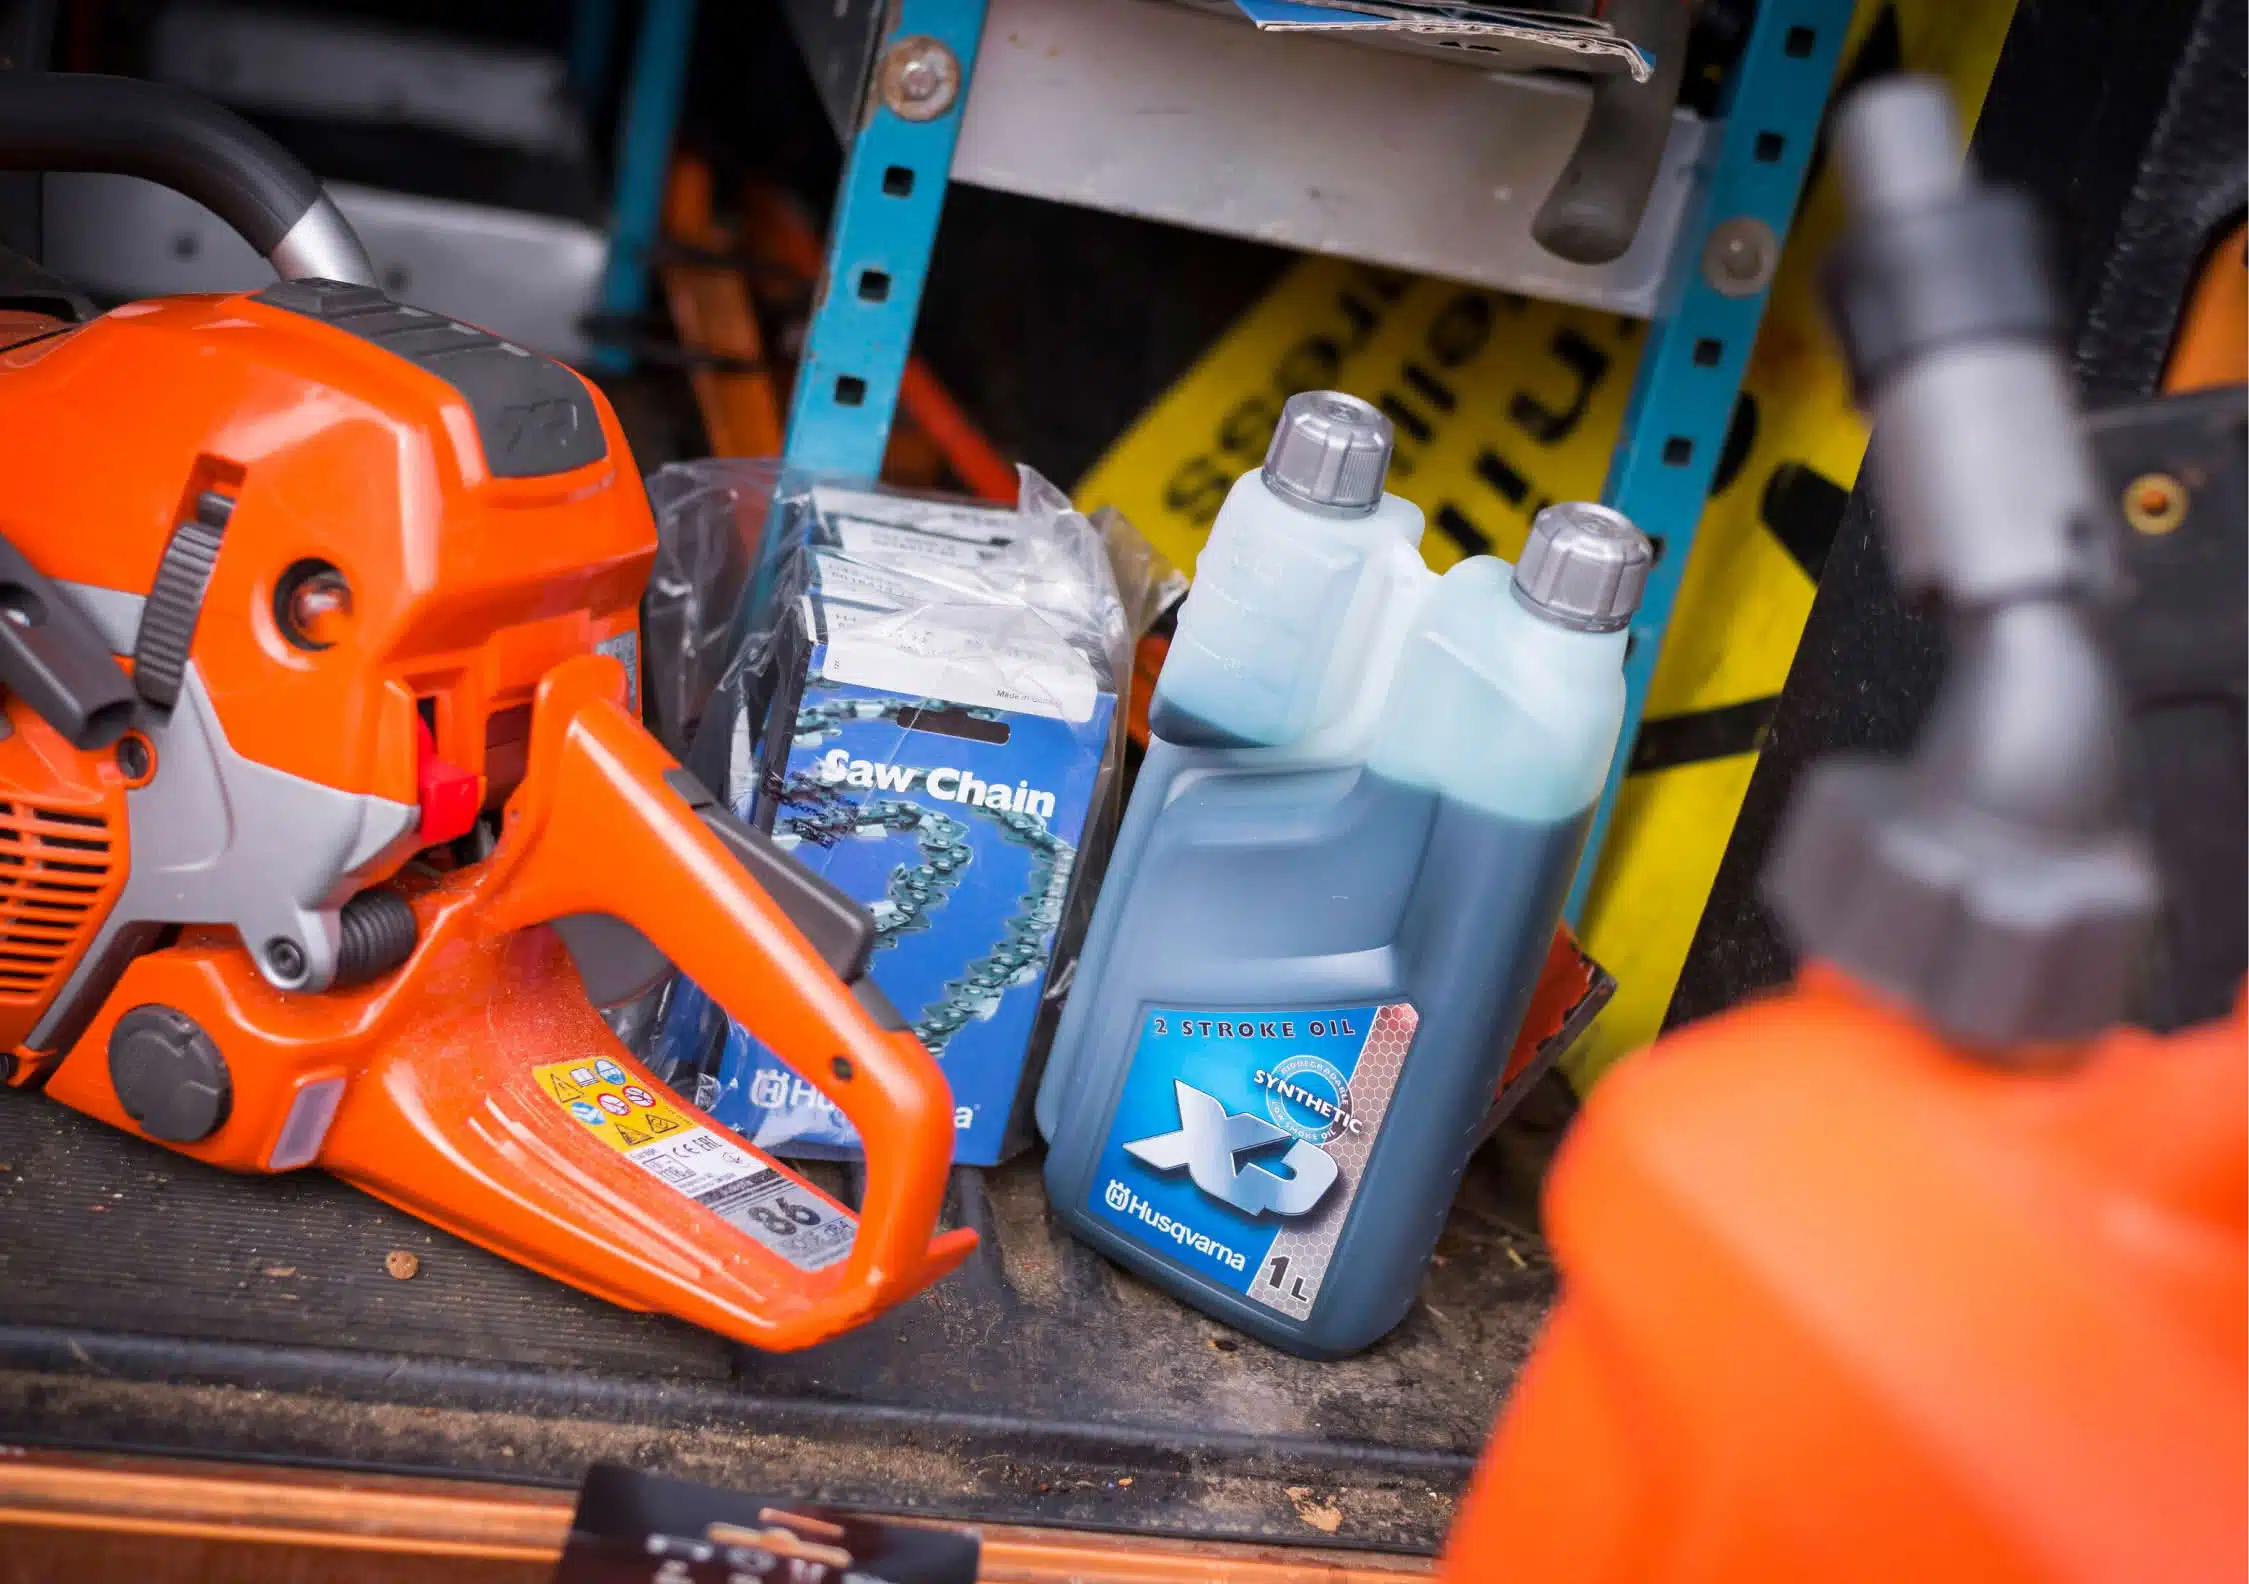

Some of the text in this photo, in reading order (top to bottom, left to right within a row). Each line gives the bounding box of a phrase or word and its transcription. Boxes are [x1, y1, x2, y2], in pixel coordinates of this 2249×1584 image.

[821, 748, 1056, 817] Saw Chain
[1154, 1018, 1356, 1038] 2 STROKE OIL
[1253, 1069, 1363, 1135] SYNTHETIC
[1121, 1078, 1339, 1217] XP
[747, 1196, 822, 1236] 86
[1127, 1194, 1247, 1272] Husqvarna
[1268, 1255, 1309, 1303] 1 L
